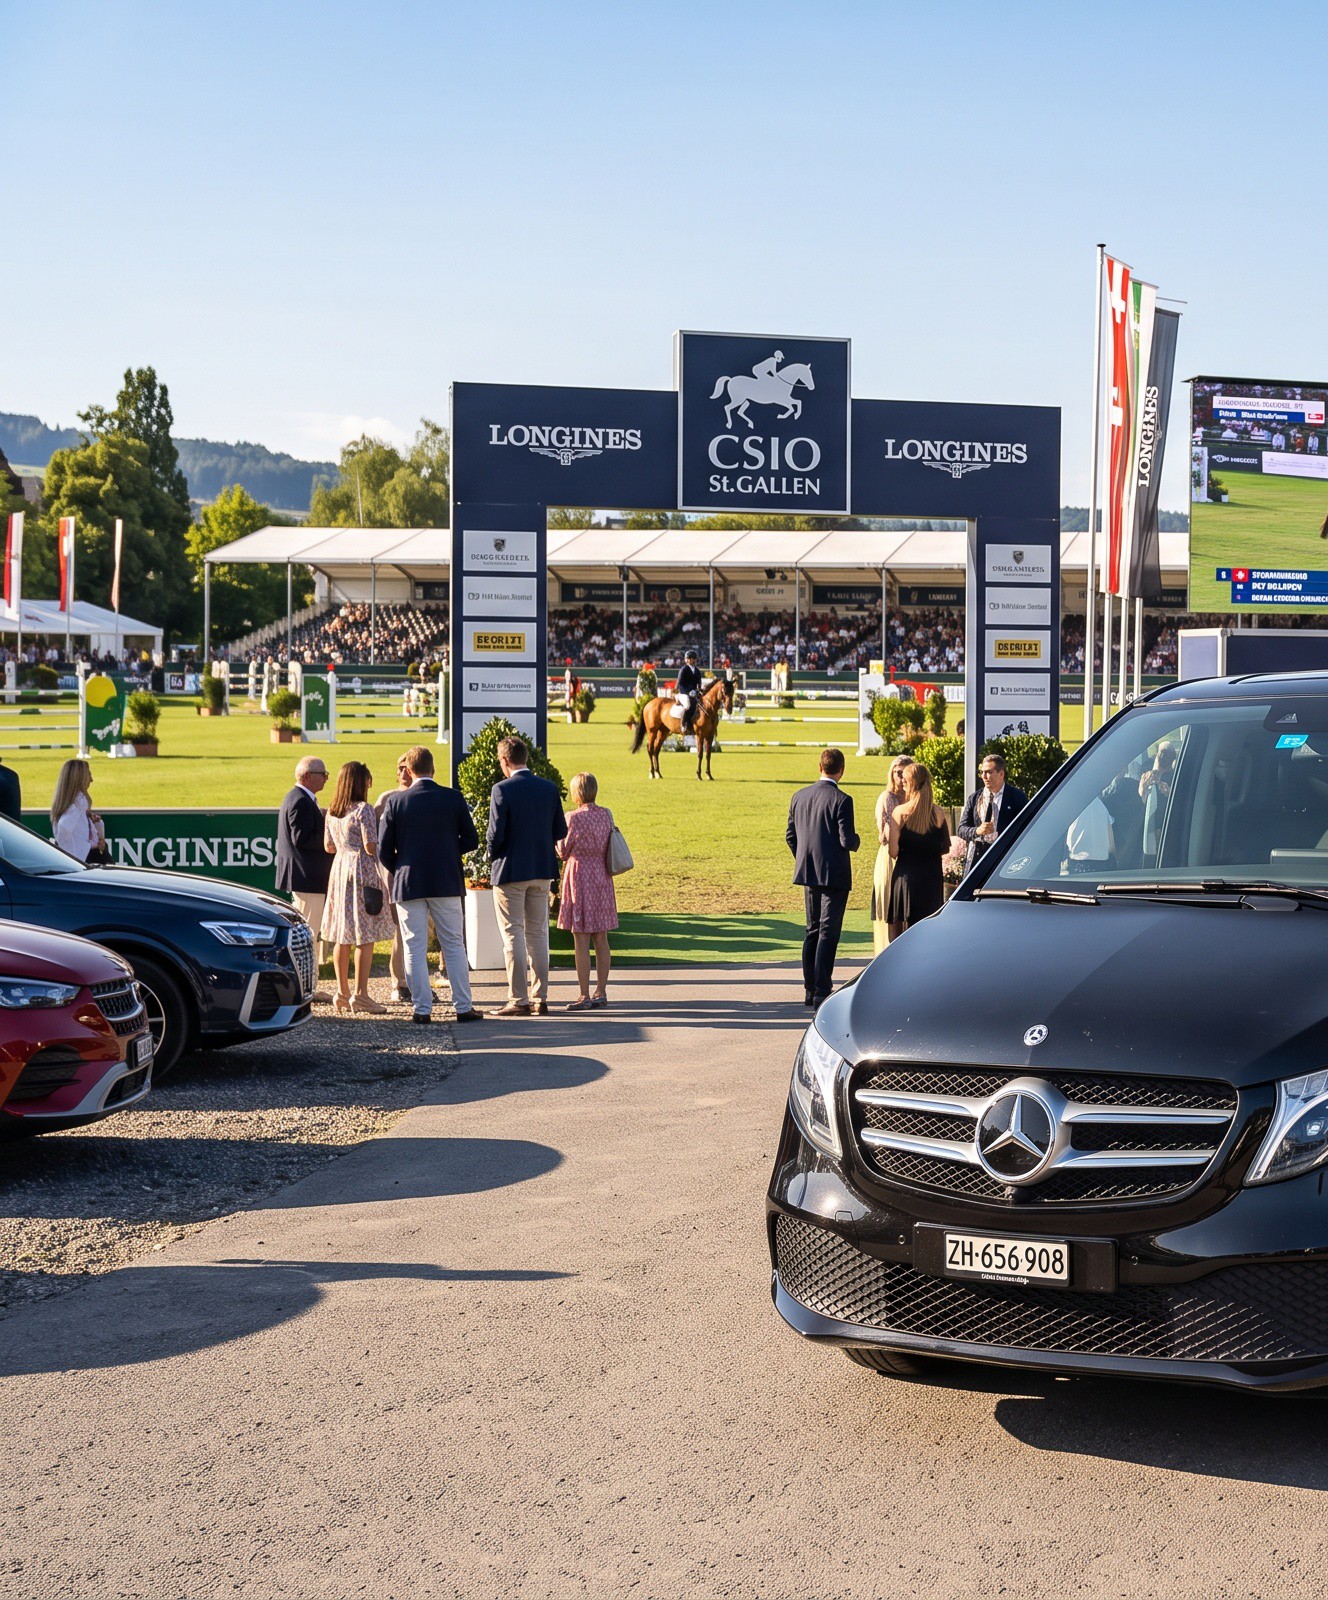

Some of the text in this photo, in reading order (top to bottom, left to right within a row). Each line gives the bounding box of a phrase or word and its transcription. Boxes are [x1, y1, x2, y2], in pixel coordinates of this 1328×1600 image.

[488, 424, 642, 451] LONGINES
[1138, 386, 1159, 488] LONGINES
[708, 434, 821, 472] CSIO
[884, 438, 1028, 464] LONGINES
[709, 474, 820, 496] St.GALLEN
